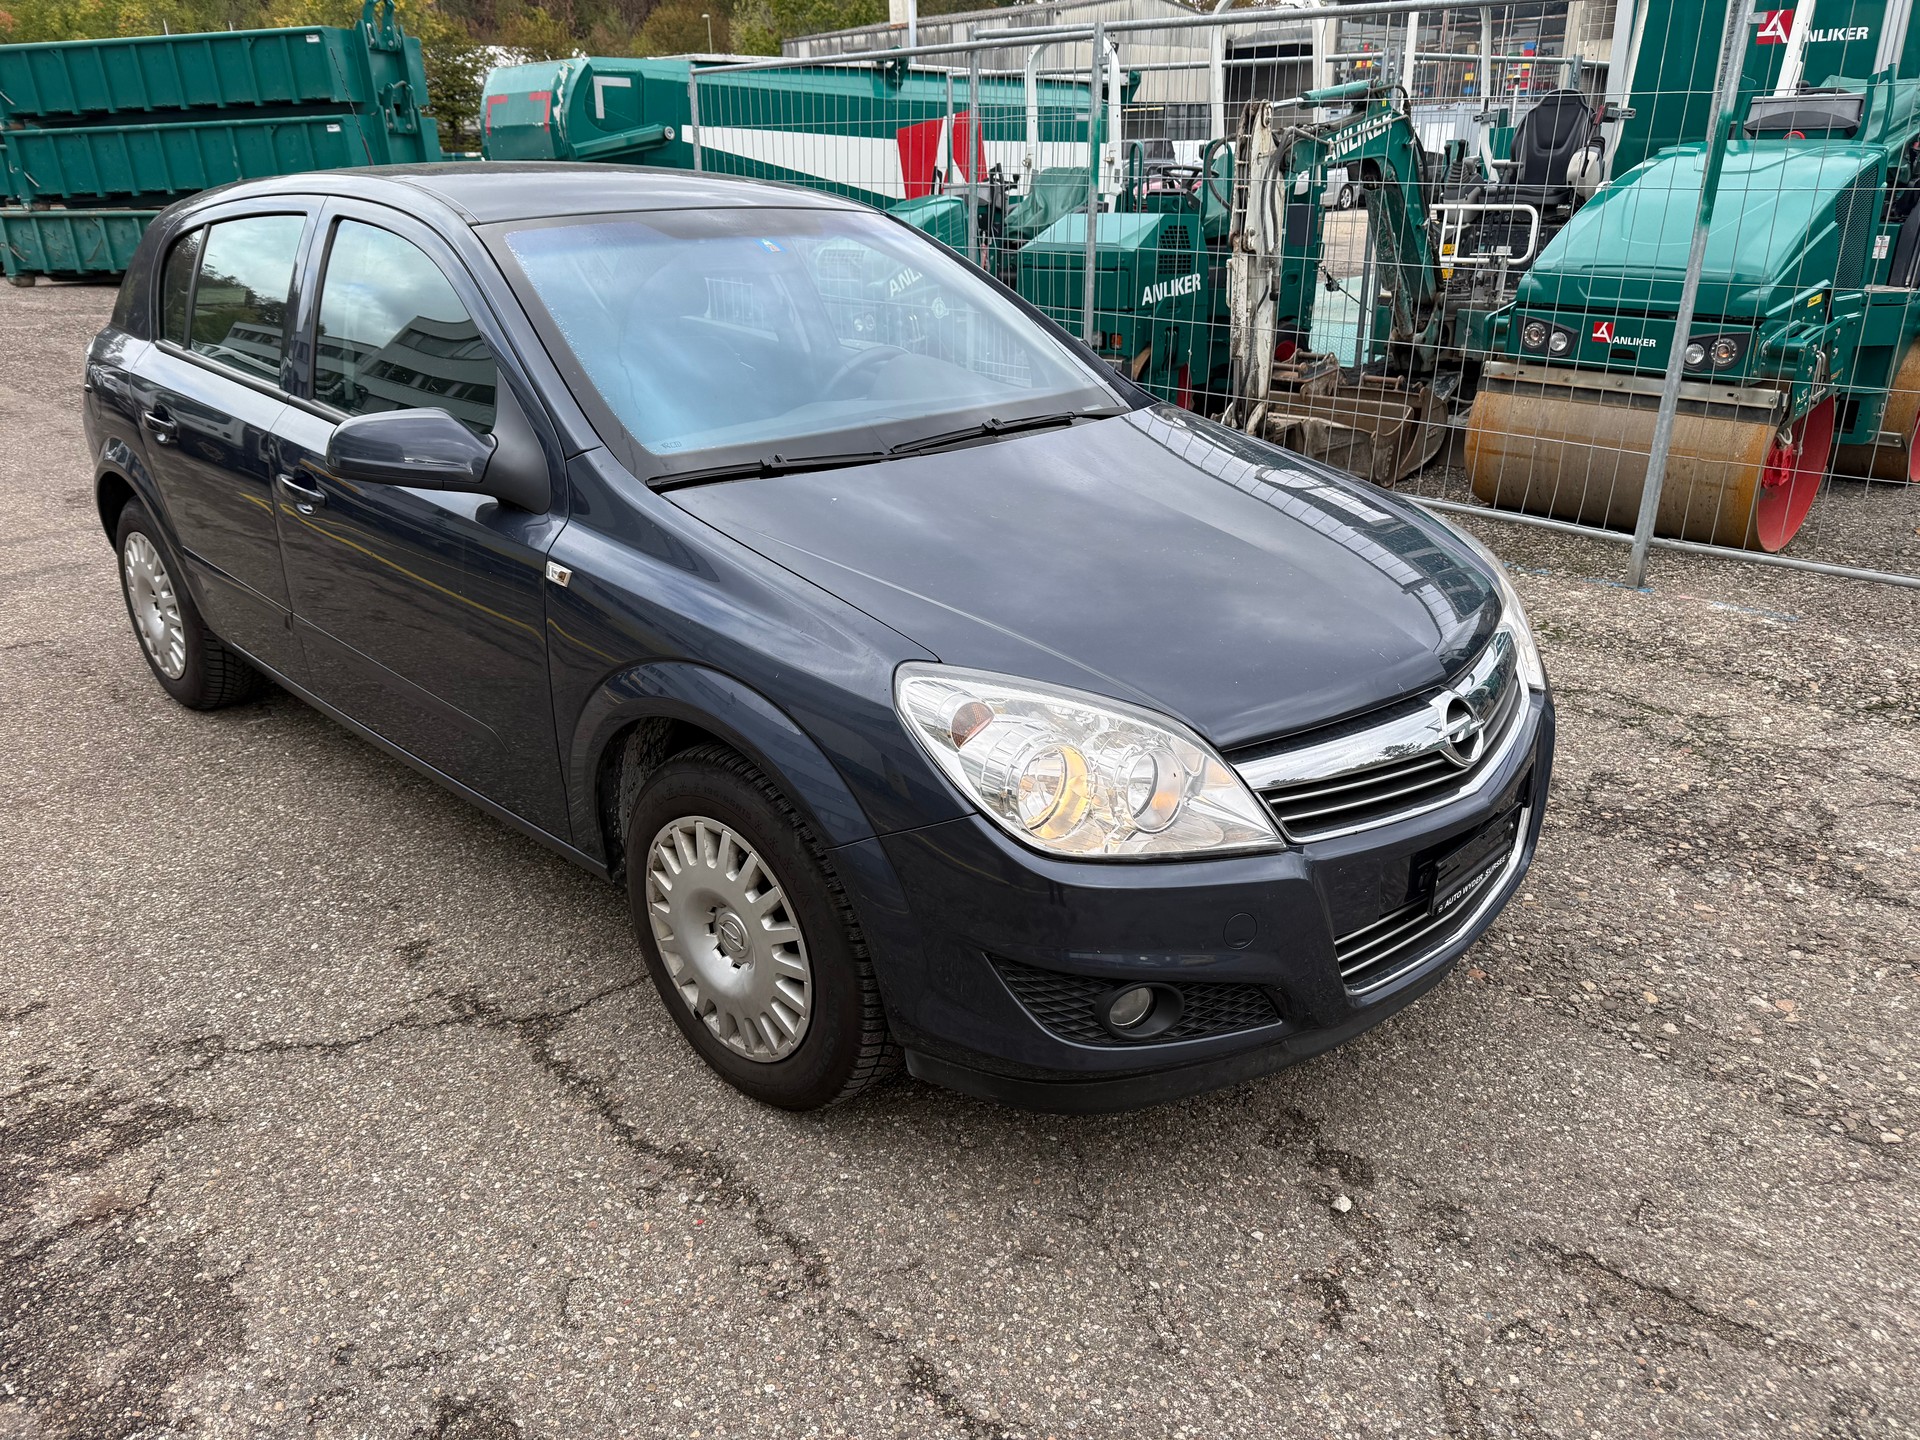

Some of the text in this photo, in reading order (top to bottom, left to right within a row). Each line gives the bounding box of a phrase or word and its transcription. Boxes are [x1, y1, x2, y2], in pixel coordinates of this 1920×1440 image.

[1804, 26, 1869, 42] NLIKER
[1142, 273, 1201, 306] ANLIKER
[1612, 336, 1657, 347] ANLIKER
[1444, 890, 1462, 908] AUTO
